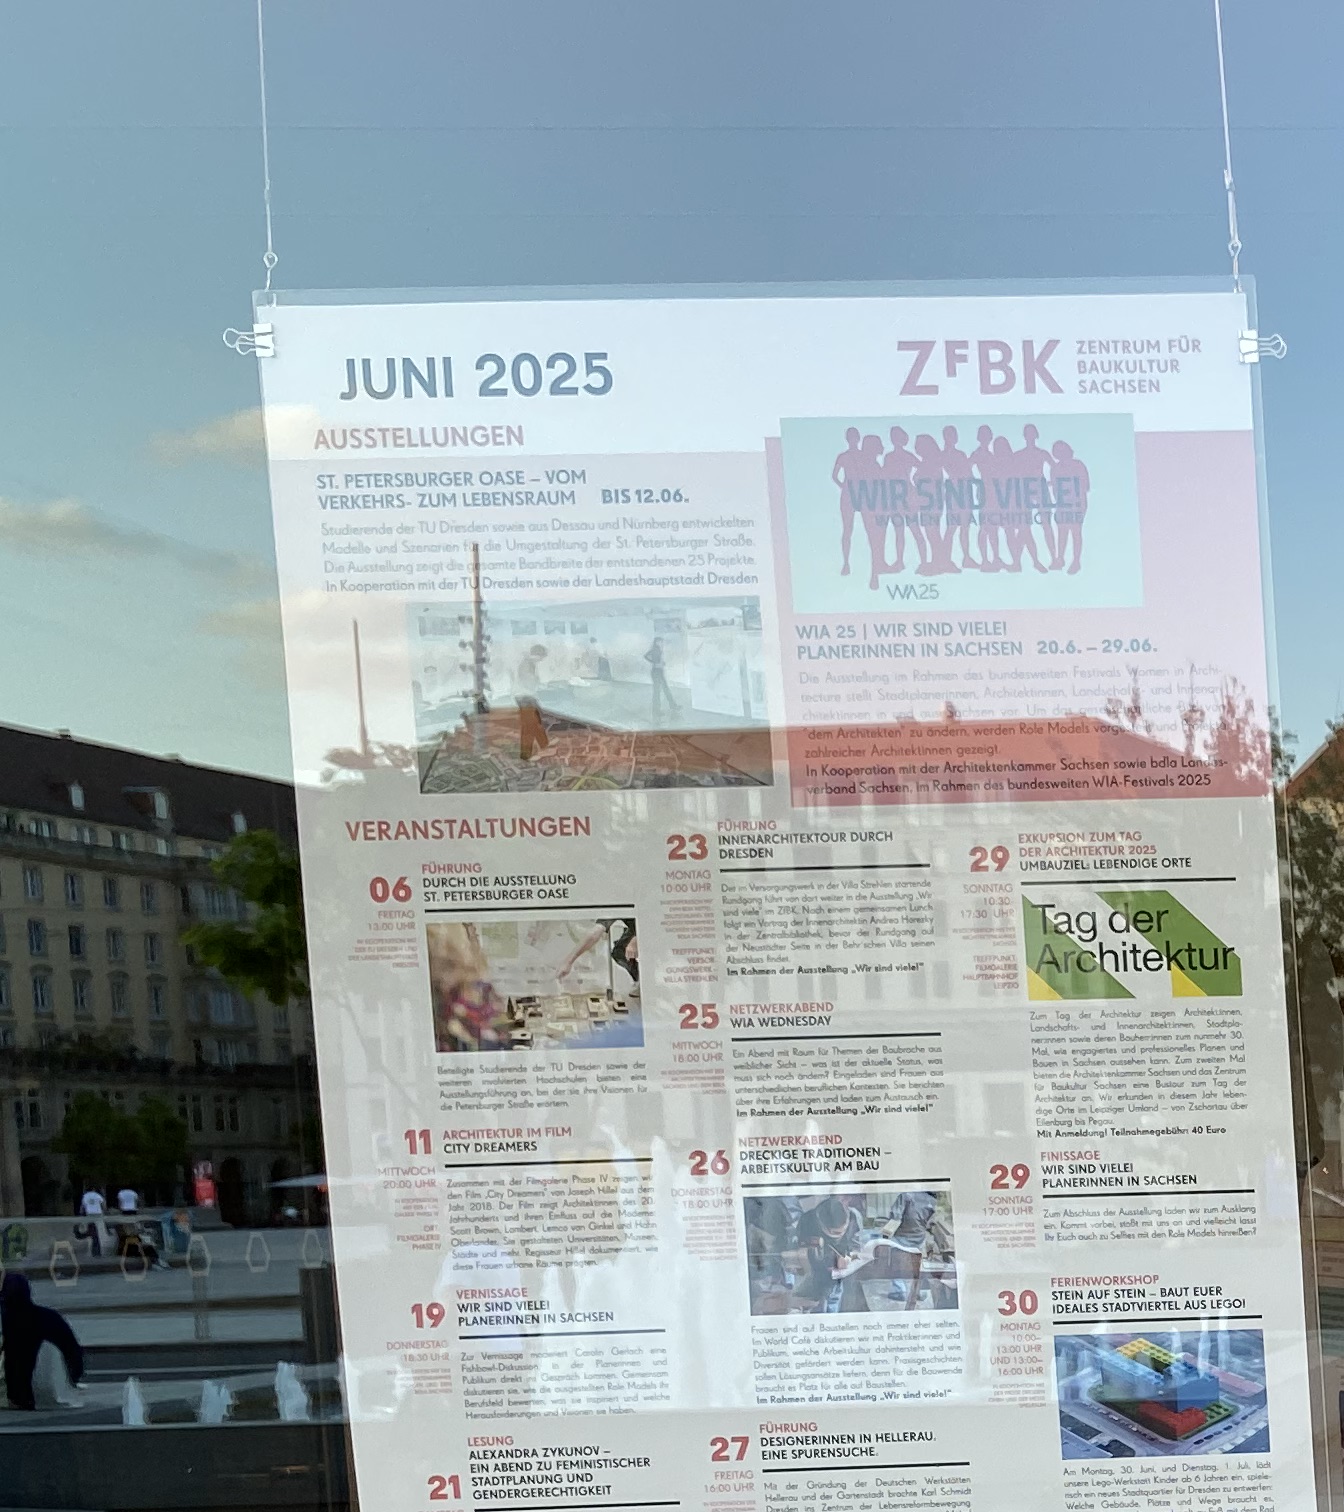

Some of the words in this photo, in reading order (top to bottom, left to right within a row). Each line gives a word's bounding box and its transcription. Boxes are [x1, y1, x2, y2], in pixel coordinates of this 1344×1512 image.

[1075, 339, 1161, 355] ZENTRUM
[1167, 335, 1201, 353] FÜR
[339, 356, 454, 400] JUNI
[475, 351, 614, 398] 2025
[1077, 359, 1180, 375] BAUKULTUR
[1078, 379, 1160, 394] SACHSEN
[314, 425, 524, 450] AUSSTELLUNGEN
[316, 474, 339, 490] ST.
[345, 472, 474, 488] PETERSBURGER
[479, 470, 526, 486] OASE
[545, 469, 587, 484] VOM
[318, 494, 412, 510] VERKEHRS-
[417, 493, 457, 508] ZUM
[462, 490, 576, 507] LEBENSRAUM
[601, 489, 631, 504] BIS
[636, 486, 690, 506] 12.06.
[847, 480, 908, 512] WIR
[915, 478, 986, 510] SIND
[994, 476, 1081, 509] VIELE!
[797, 644, 917, 660] PLANERINNEN
[921, 643, 939, 657] IN
[944, 641, 1023, 657] SACHSEN
[1036, 640, 1082, 655] 20.6.
[1102, 638, 1158, 654] 29.06.
[345, 816, 591, 842] VERANSTALTUNGEN
[717, 820, 777, 831] FÜHRUNG
[666, 834, 709, 861] 23
[718, 833, 846, 846] INNENARCHITEKTOUR
[850, 831, 893, 842] DURCH
[719, 848, 774, 860] DRESDEN
[969, 846, 1011, 873] 29
[422, 862, 482, 875] FÜHRUNG
[369, 876, 413, 904] 06
[1031, 903, 1097, 942] Tag
[1108, 902, 1169, 934] der
[1035, 941, 1235, 973] Architektur
[678, 1003, 720, 1030] 25
[729, 1002, 834, 1015] NETZWERKABEND
[404, 1128, 432, 1155] 11
[443, 1128, 523, 1140] ARCHITEKTUR
[526, 1127, 542, 1138] IM
[545, 1126, 572, 1137] FILM
[739, 1134, 843, 1147] NETZWERKABEND
[443, 1142, 471, 1154] CITY
[474, 1141, 537, 1153] DREAMERS
[688, 1150, 730, 1176] 26
[1050, 1275, 1159, 1287] FERIENWORKSHOP
[456, 1288, 528, 1299] VERNISSAGE
[998, 1290, 1039, 1316] 30
[410, 1302, 445, 1329] 19
[467, 1436, 513, 1447] LESUNG
[468, 1448, 539, 1460] ALEXANDRA
[542, 1446, 600, 1457] ZYKUNOV
[427, 1475, 462, 1500] 21
[472, 1484, 612, 1500] GENDERGERECHTIGKEIT
